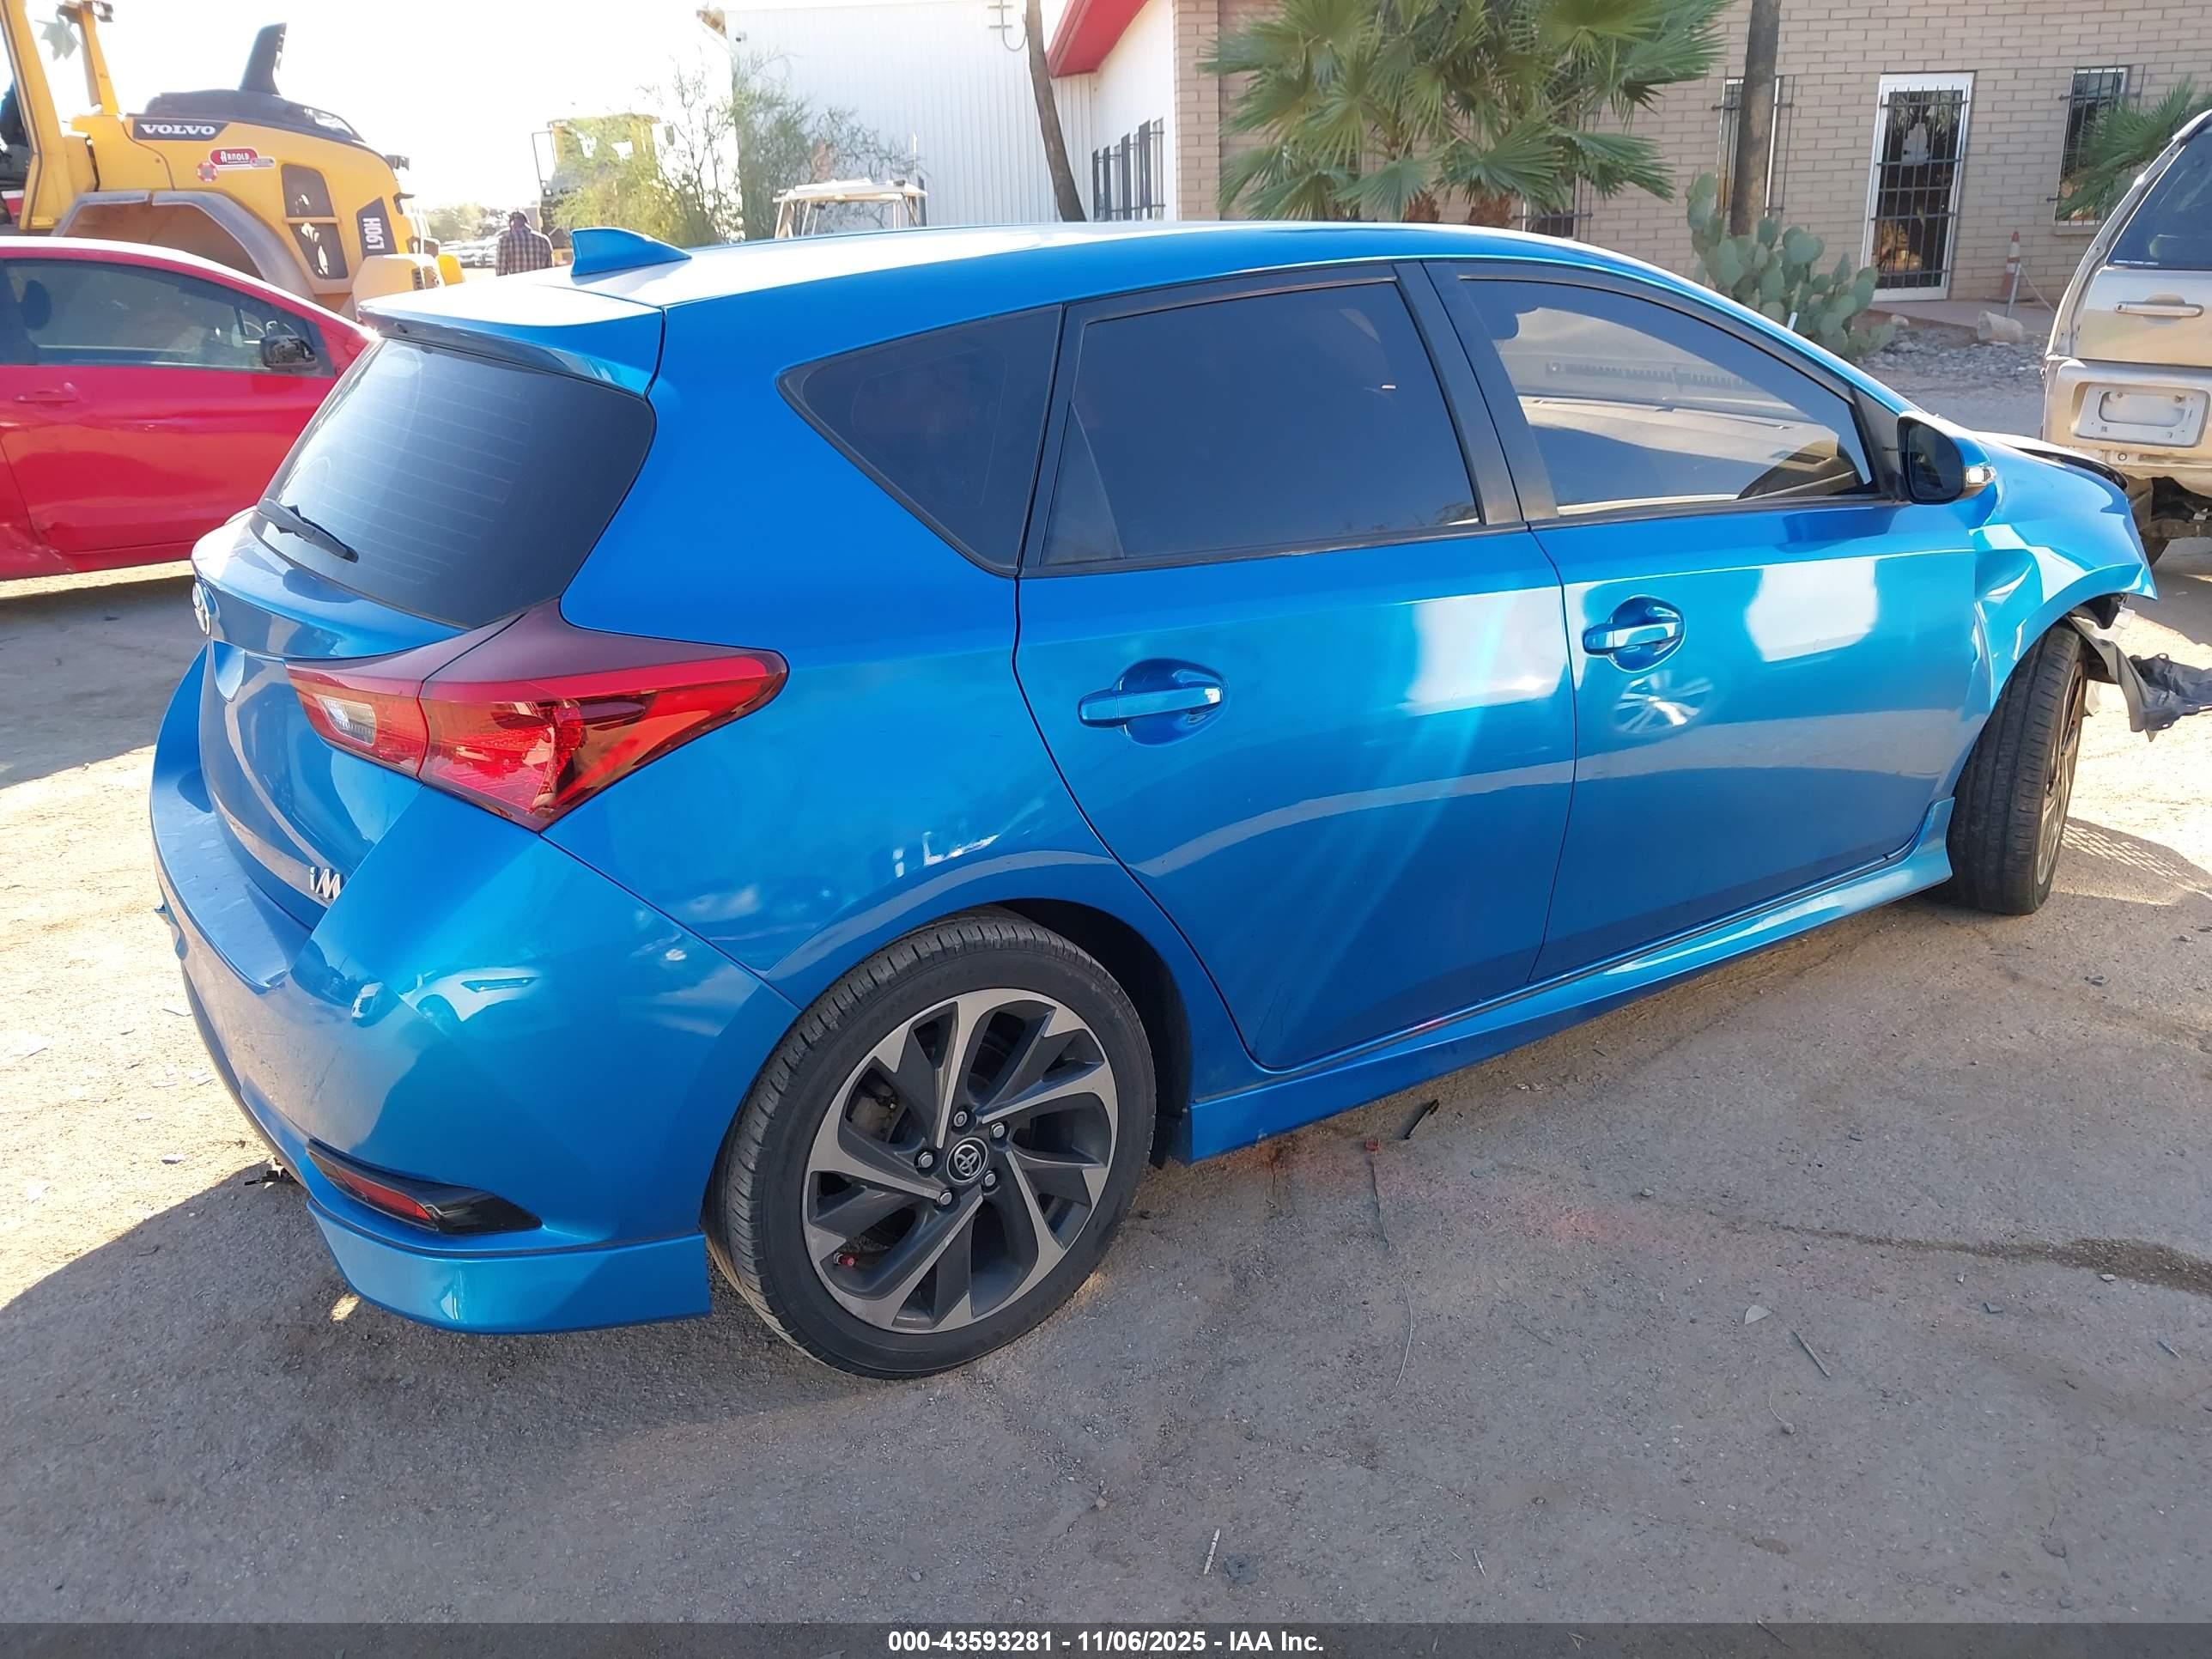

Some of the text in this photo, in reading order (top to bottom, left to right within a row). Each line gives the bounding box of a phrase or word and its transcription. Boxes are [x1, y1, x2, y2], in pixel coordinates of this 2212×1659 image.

[140, 124, 216, 136] VOLVO
[220, 150, 251, 163] ARNOLD
[362, 217, 386, 250] L90H
